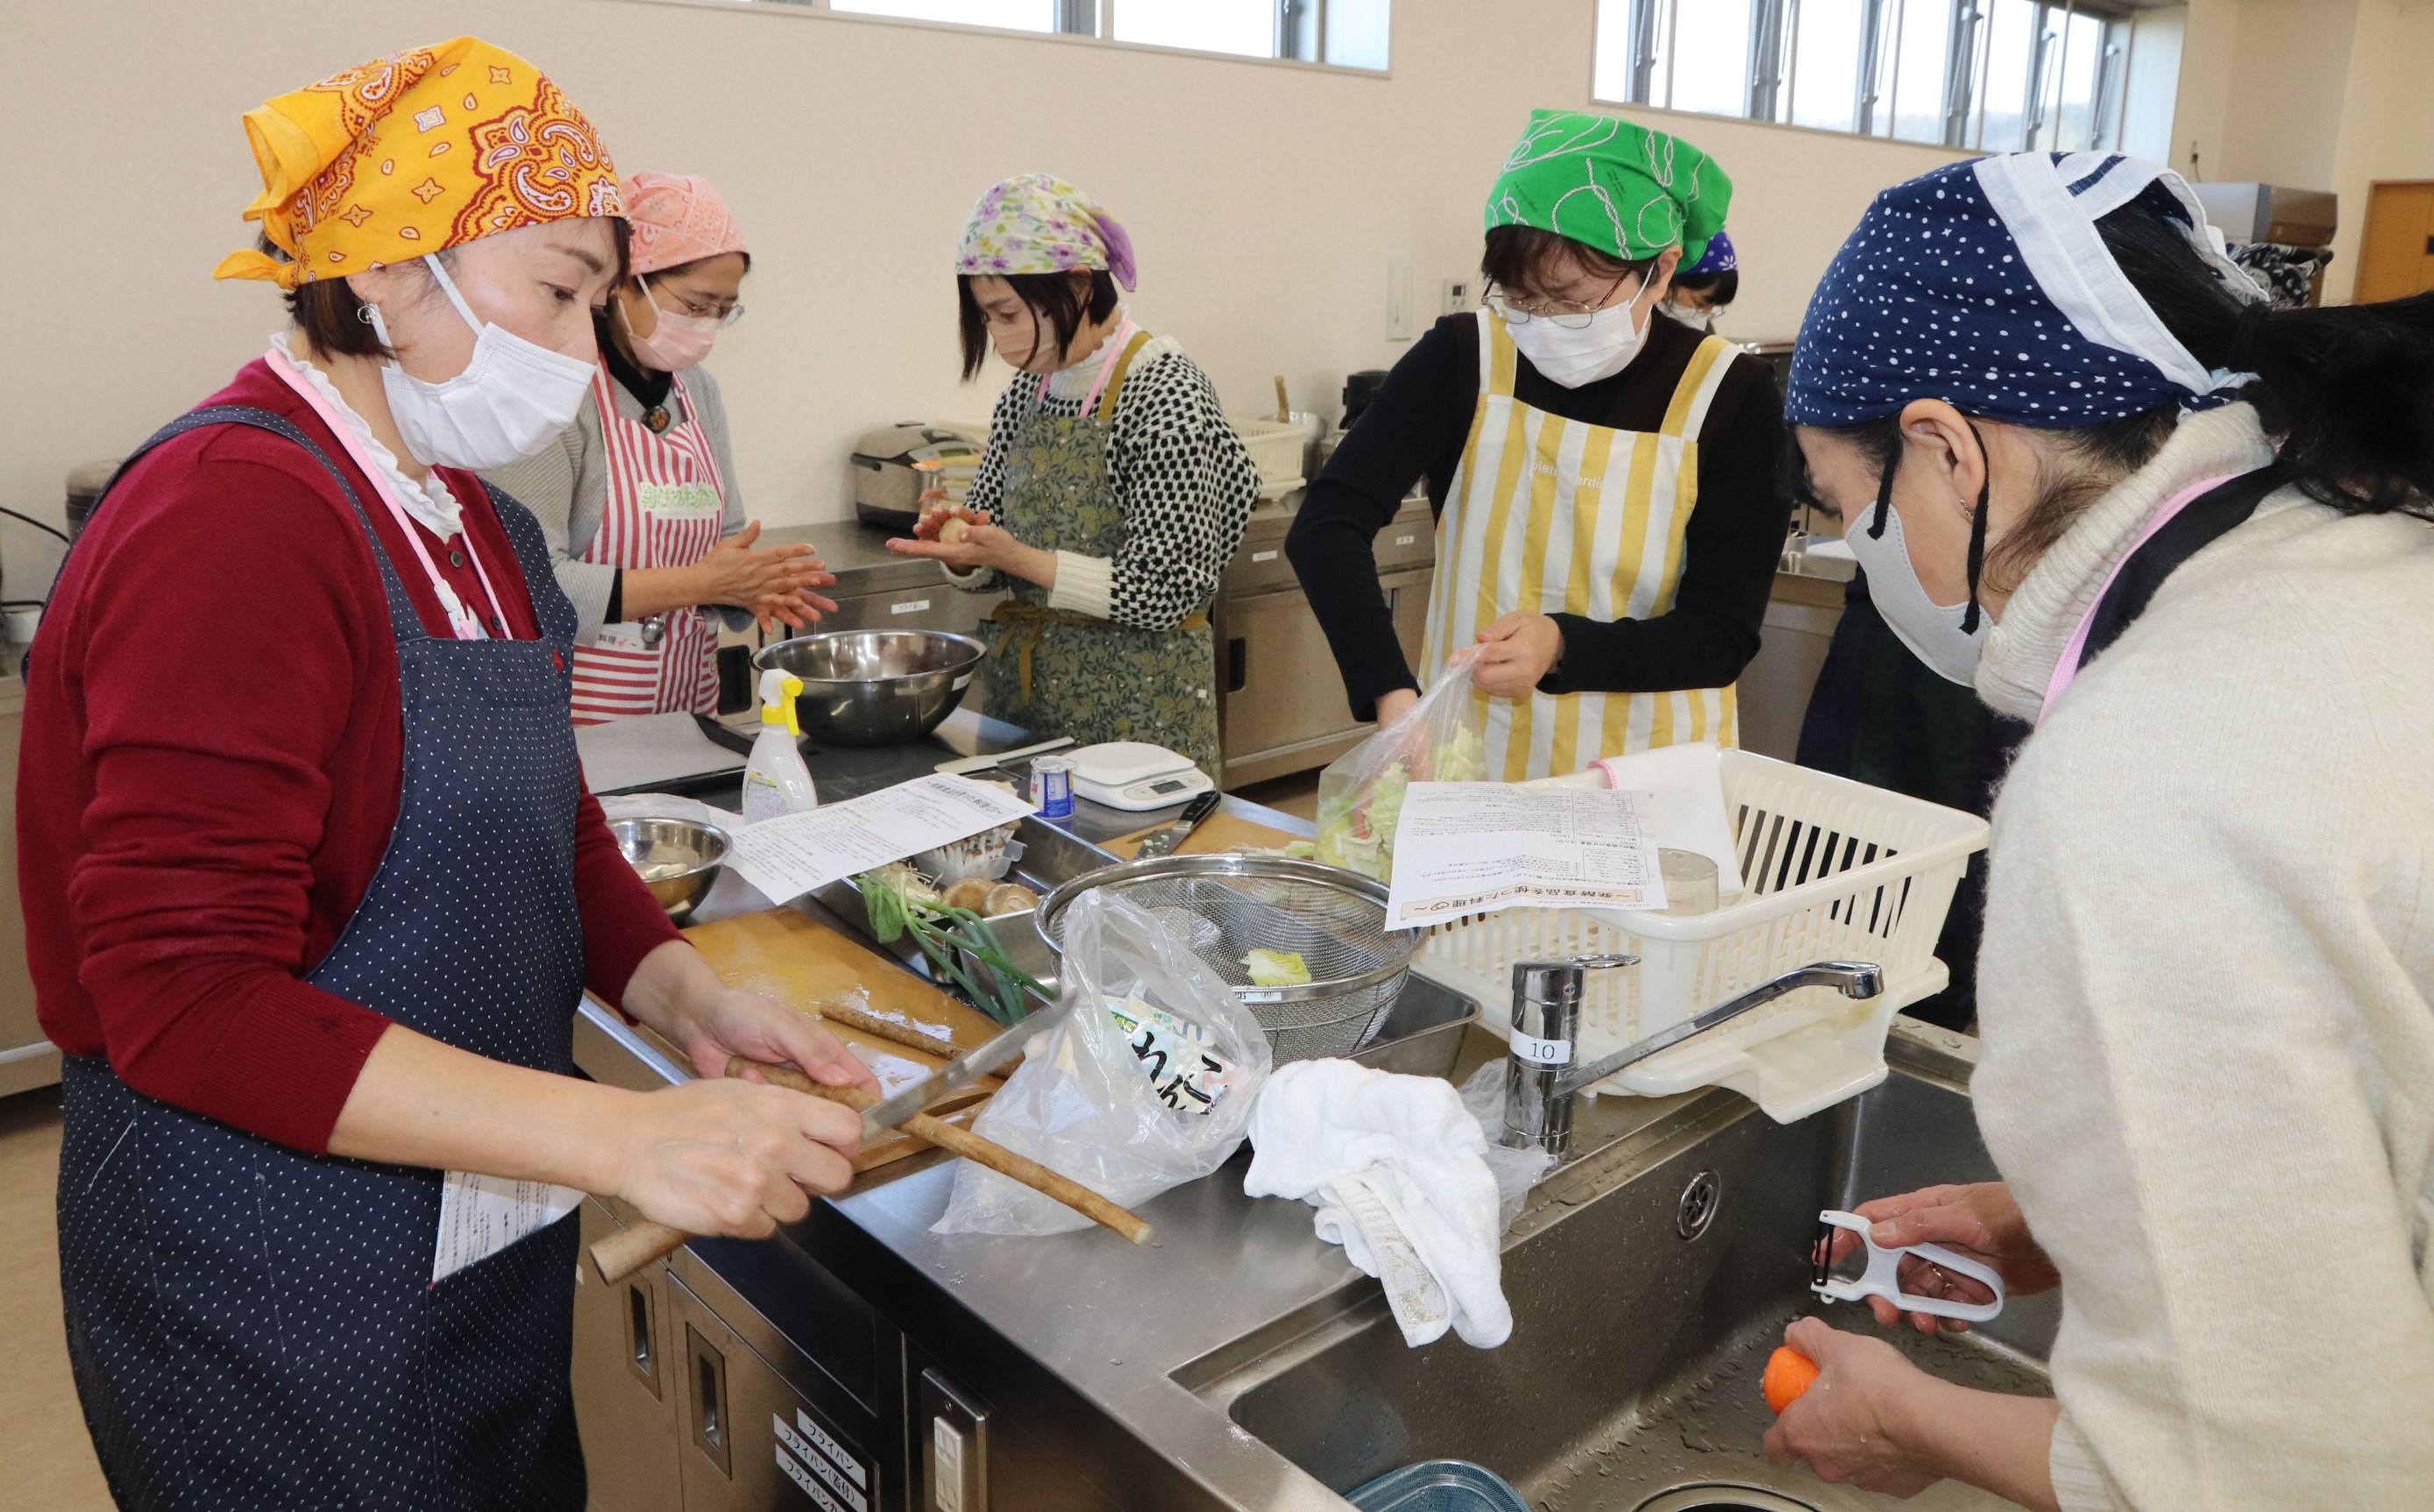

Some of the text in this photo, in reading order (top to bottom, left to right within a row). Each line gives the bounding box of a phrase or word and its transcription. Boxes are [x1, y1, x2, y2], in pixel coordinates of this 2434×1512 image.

[1529, 1043, 1555, 1060] 10
[807, 1421, 854, 1470] フライパン
